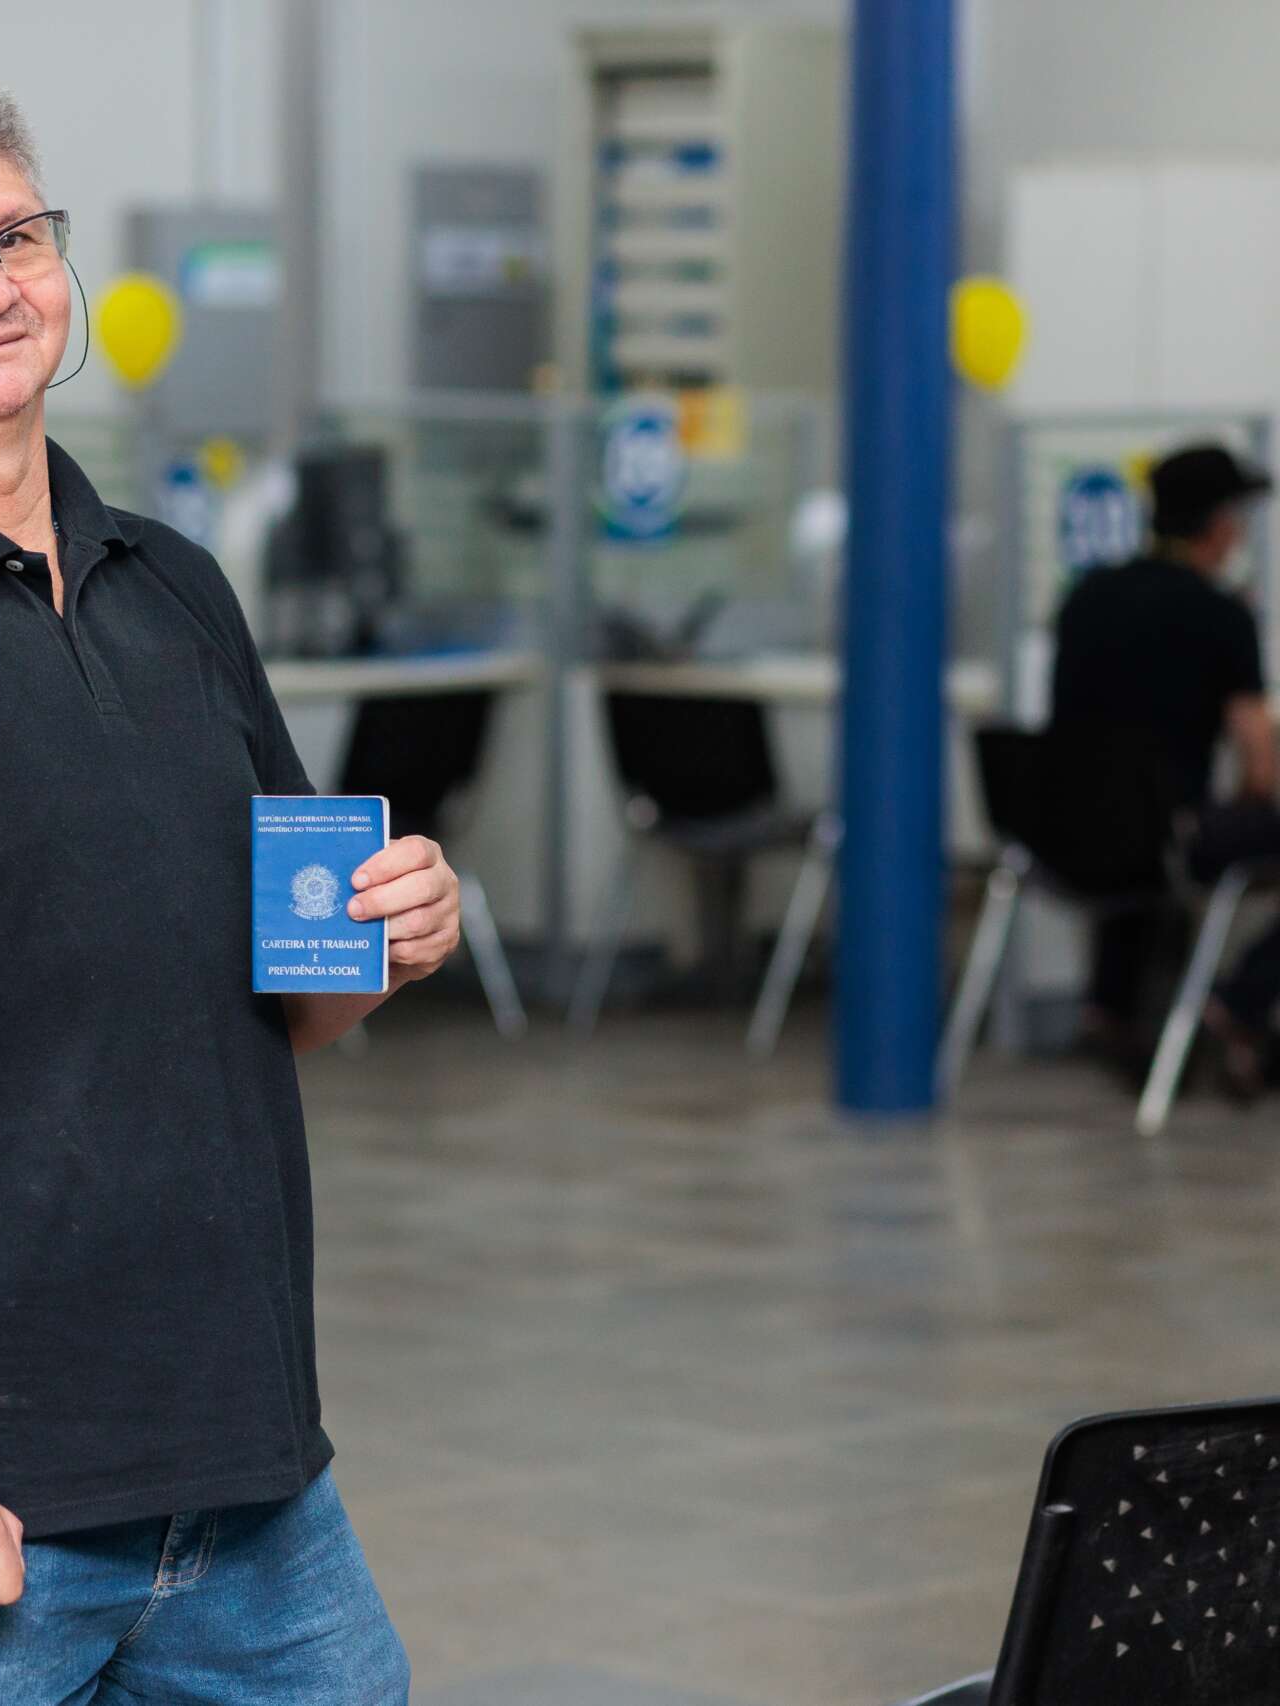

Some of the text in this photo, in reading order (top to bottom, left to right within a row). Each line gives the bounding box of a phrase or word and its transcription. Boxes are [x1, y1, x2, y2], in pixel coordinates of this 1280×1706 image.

[258, 814, 371, 823] REPÚBLICA FEDERATIVA DO BRASIL
[258, 825, 293, 833] MINISTÉRIO
[262, 939, 369, 949] CARTEIRA DE TRABALHO
[313, 953, 319, 962] E
[268, 964, 361, 976] PREVIDÊNCIA SOCIAL
